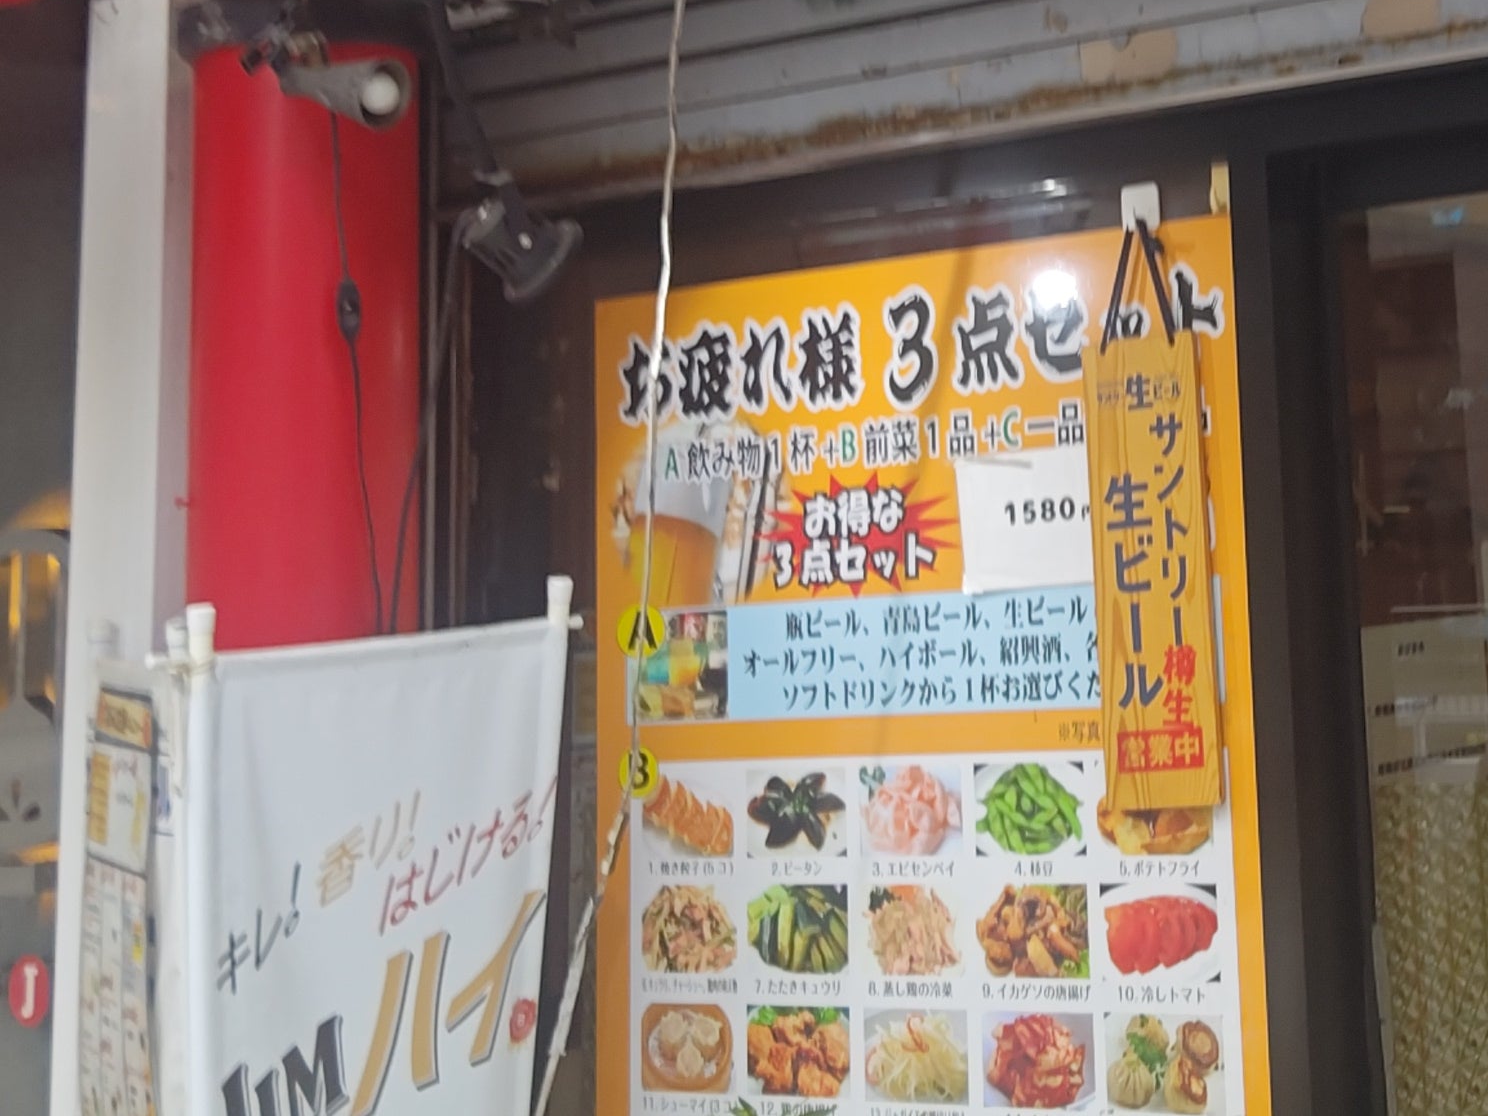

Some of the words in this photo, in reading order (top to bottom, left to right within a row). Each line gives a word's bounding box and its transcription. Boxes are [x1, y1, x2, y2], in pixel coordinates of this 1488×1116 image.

[803, 486, 905, 539] お得な
[1149, 411, 1189, 647] サントリー
[773, 534, 936, 590] 3点セット
[1104, 472, 1164, 711] 生ビール
[628, 610, 658, 651] A
[1120, 733, 1201, 770] 営業中
